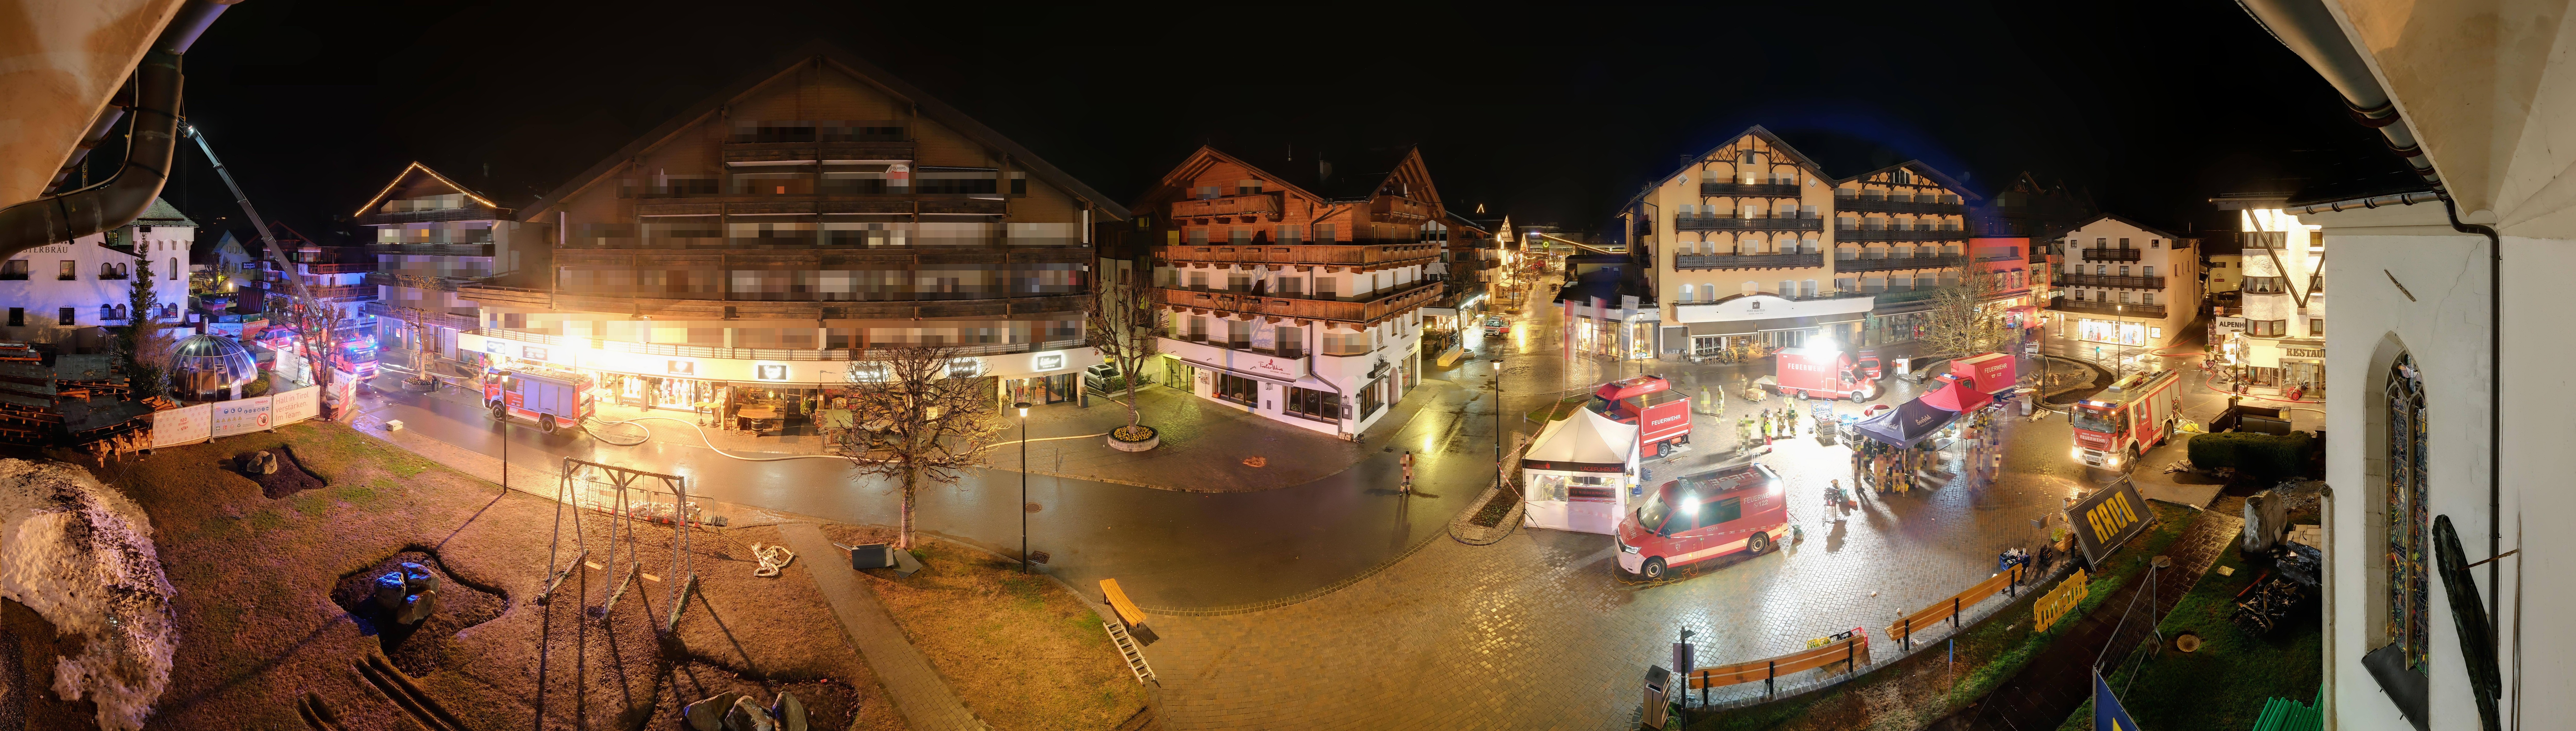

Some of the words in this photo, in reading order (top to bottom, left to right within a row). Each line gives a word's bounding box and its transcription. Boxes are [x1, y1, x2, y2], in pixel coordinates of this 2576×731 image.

[1406, 343, 1414, 351] SAILER
[1375, 364, 1389, 377] RESTAURANT
[1788, 363, 1825, 372] FEUERWEHR
[1985, 363, 2007, 373] FEUERWEHR
[276, 396, 287, 404] Hall
[296, 391, 309, 400] Tirol
[276, 402, 307, 413] verstärken.
[1971, 401, 1986, 410] FEUERWEHR
[1651, 414, 1681, 426] FEUERWEHR
[1916, 414, 1931, 425] Seefeld
